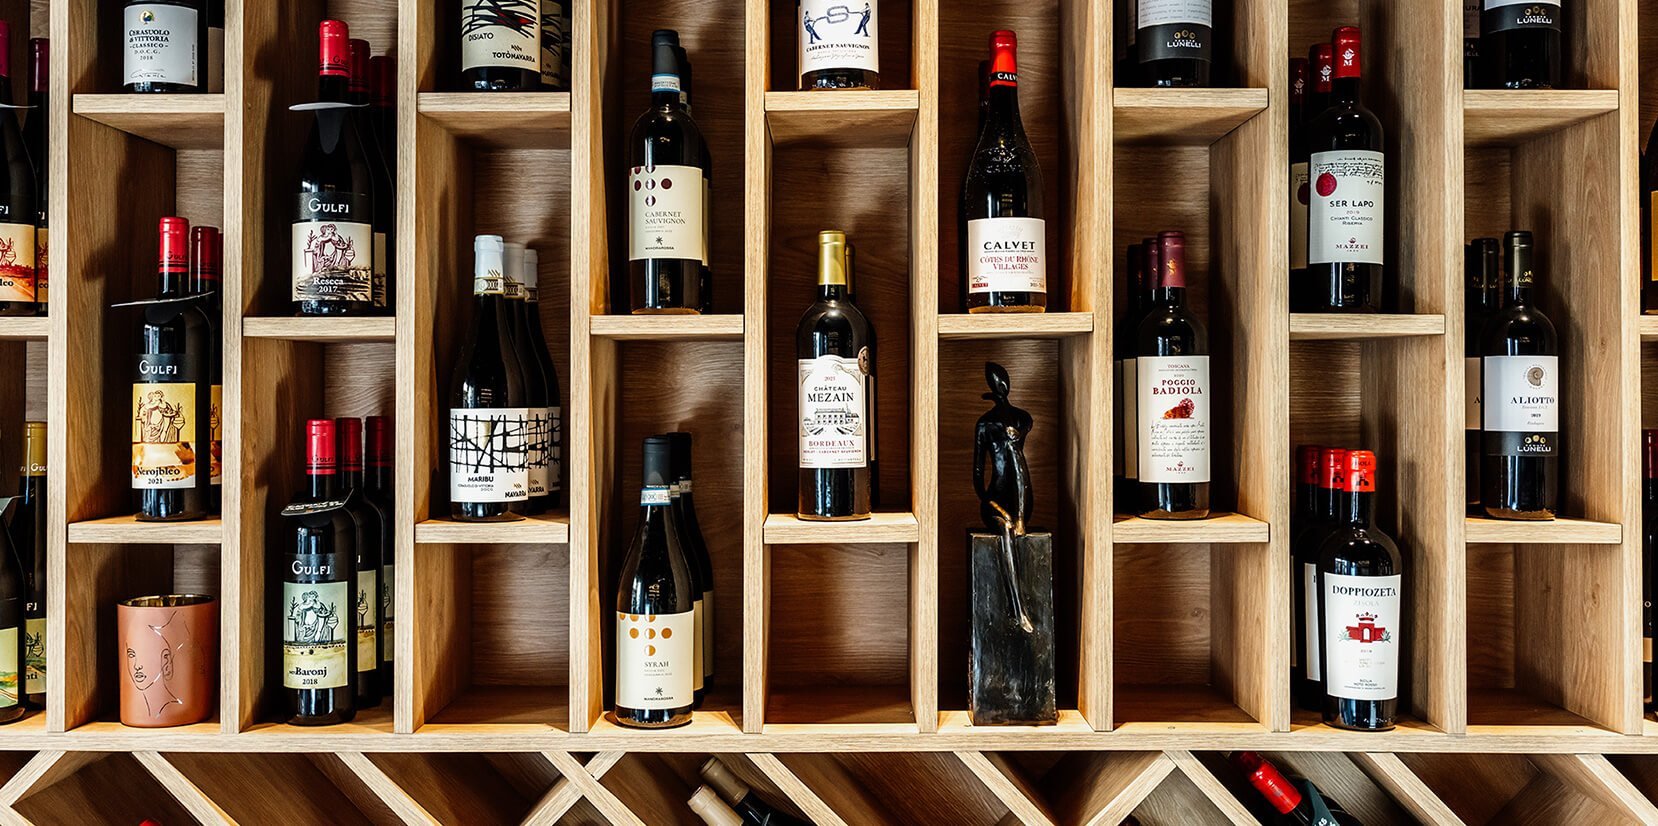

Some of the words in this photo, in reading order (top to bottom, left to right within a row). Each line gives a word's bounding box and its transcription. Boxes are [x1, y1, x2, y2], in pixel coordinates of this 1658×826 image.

[128, 29, 170, 37] CERASUOLO
[468, 32, 494, 42] DISIATO
[134, 35, 170, 43] VITTORIA
[308, 198, 350, 214] GULFI
[1329, 200, 1348, 208] SER
[1352, 200, 1374, 208] LAPO
[644, 217, 687, 225] SAUVIGNON
[983, 241, 1036, 251] CALVET
[992, 263, 1030, 271] VILLAGES
[318, 285, 338, 293] 2017
[139, 359, 178, 375] GULFI
[1161, 379, 1196, 387] POGGIO
[1152, 387, 1203, 396] BADIOLA
[807, 392, 855, 403] MEZAIN
[1510, 396, 1555, 405] ALIOTTO
[808, 440, 855, 448] BORDEAUX
[467, 475, 494, 483] MARIBU
[291, 559, 331, 575] GULFI
[1332, 585, 1397, 597] DOPPIOZETA
[643, 660, 669, 668] SYRAH
